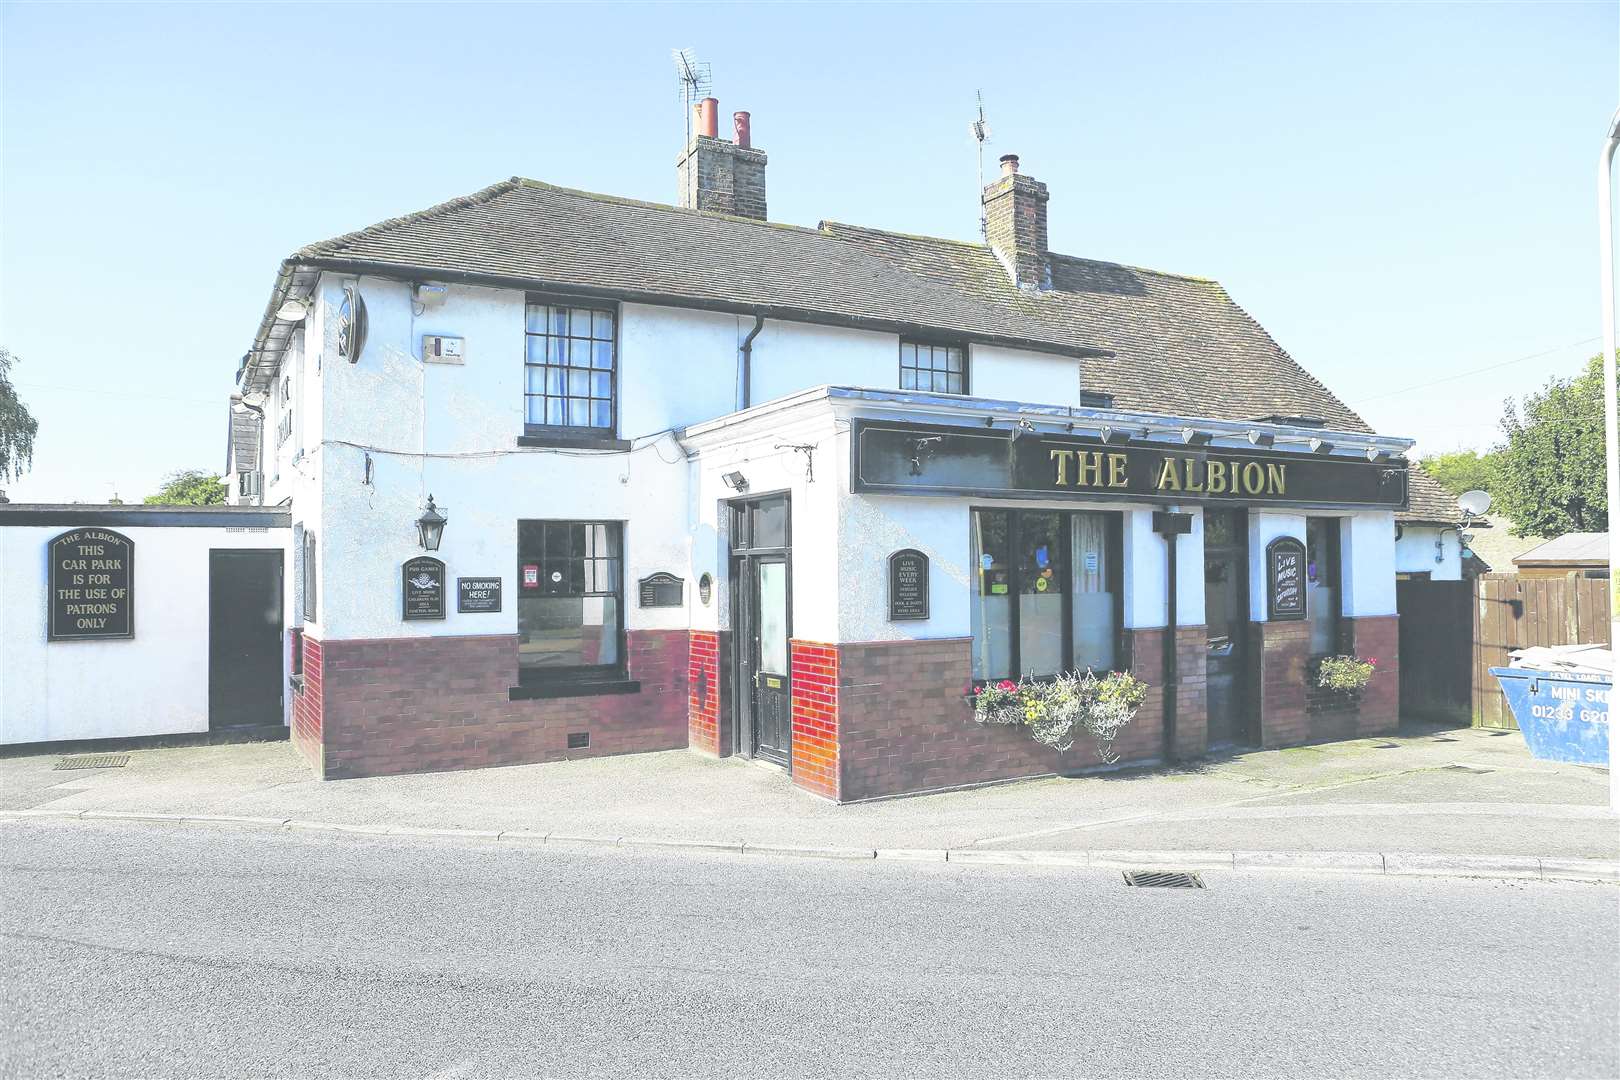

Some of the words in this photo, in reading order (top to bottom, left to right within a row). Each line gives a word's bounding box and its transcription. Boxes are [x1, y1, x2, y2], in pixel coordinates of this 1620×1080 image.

[1050, 449, 1128, 488] THE
[1157, 457, 1286, 495] ALBION
[60, 533, 80, 545] THE
[84, 532, 121, 545] ALBION
[78, 545, 104, 556] THIS
[62, 559, 87, 570] CAR
[91, 559, 121, 570] PARK
[1278, 556, 1296, 571] LIVE
[73, 574, 84, 585] IS
[88, 574, 111, 585] FOR
[1277, 567, 1296, 583] MUSIC
[461, 582, 471, 590] NO
[472, 582, 500, 590] SMOKING
[58, 589, 80, 600] THE
[85, 589, 107, 599] USE
[111, 588, 126, 599] OF
[469, 590, 491, 599] HERE!
[66, 603, 117, 614] PATRONS
[77, 618, 107, 629] ONLY
[1551, 686, 1580, 701] MINI
[1532, 705, 1574, 721] 01233
